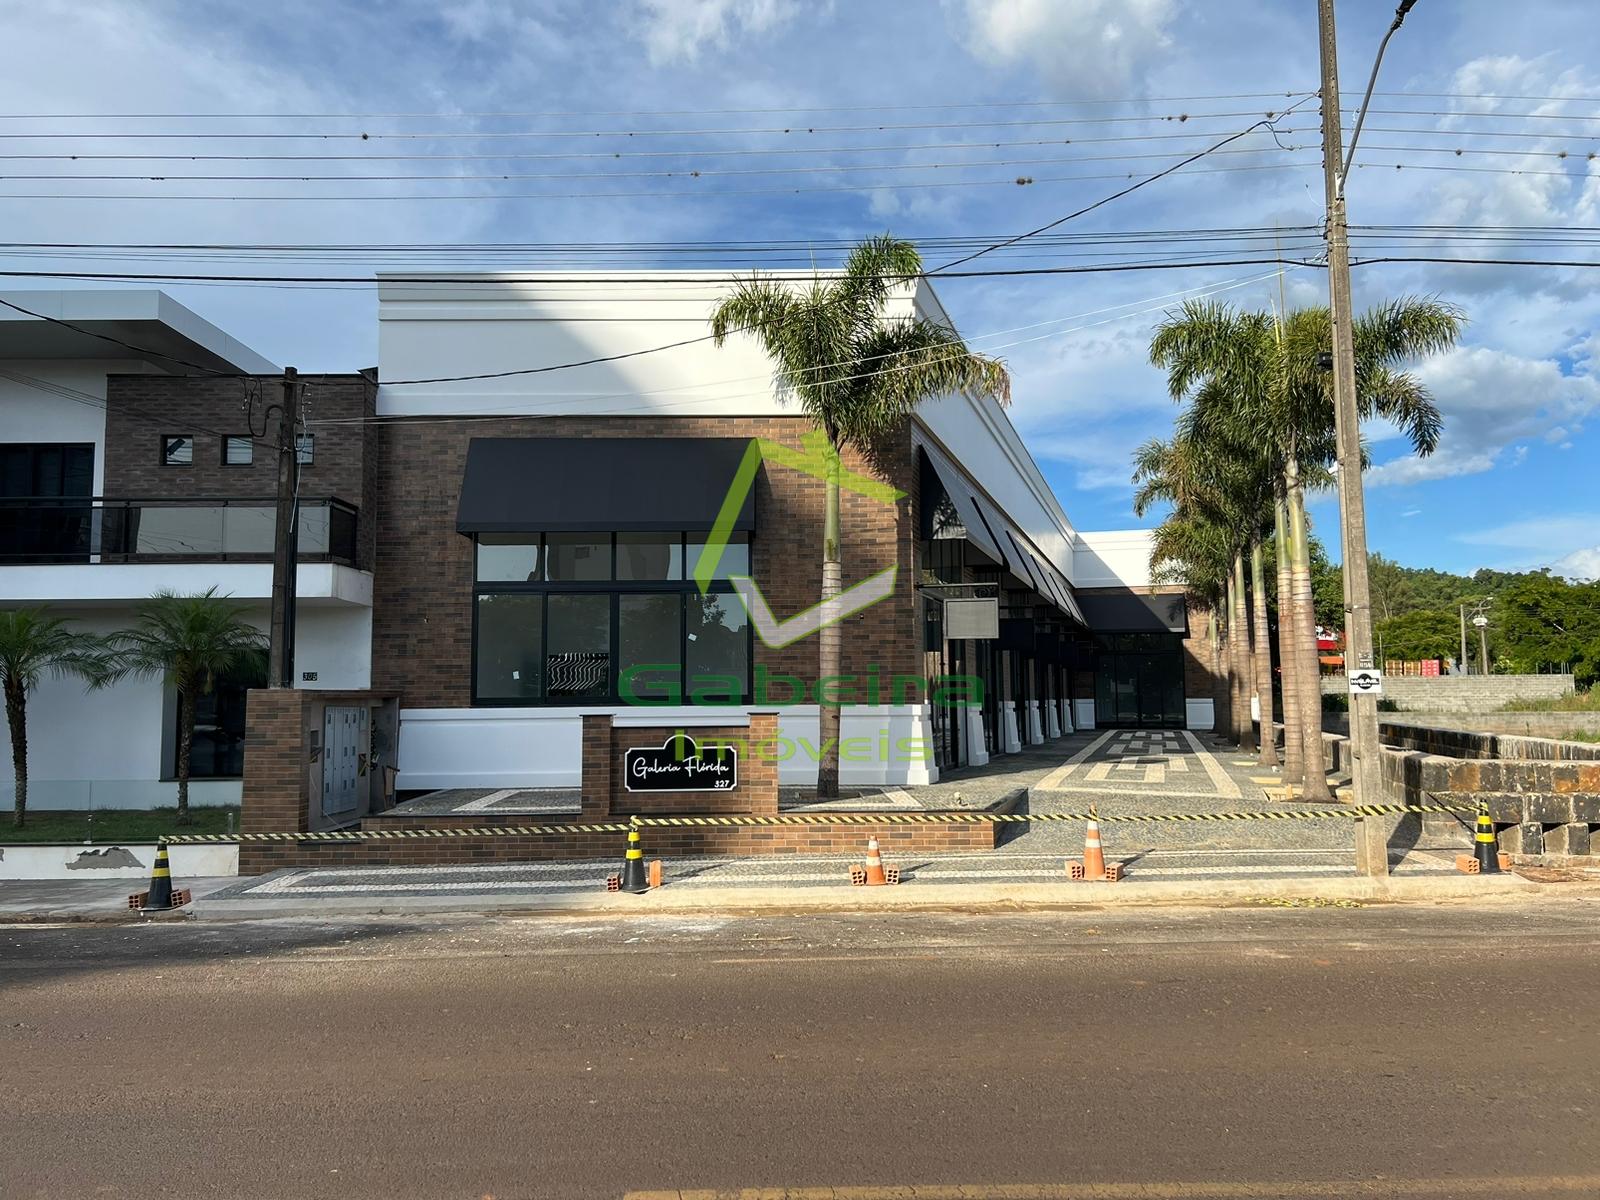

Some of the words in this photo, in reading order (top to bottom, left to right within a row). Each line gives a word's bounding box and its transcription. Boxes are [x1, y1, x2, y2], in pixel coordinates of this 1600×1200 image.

[632, 756, 681, 779] Galeria
[682, 755, 730, 778] Flórida
[714, 780, 730, 788] 327
